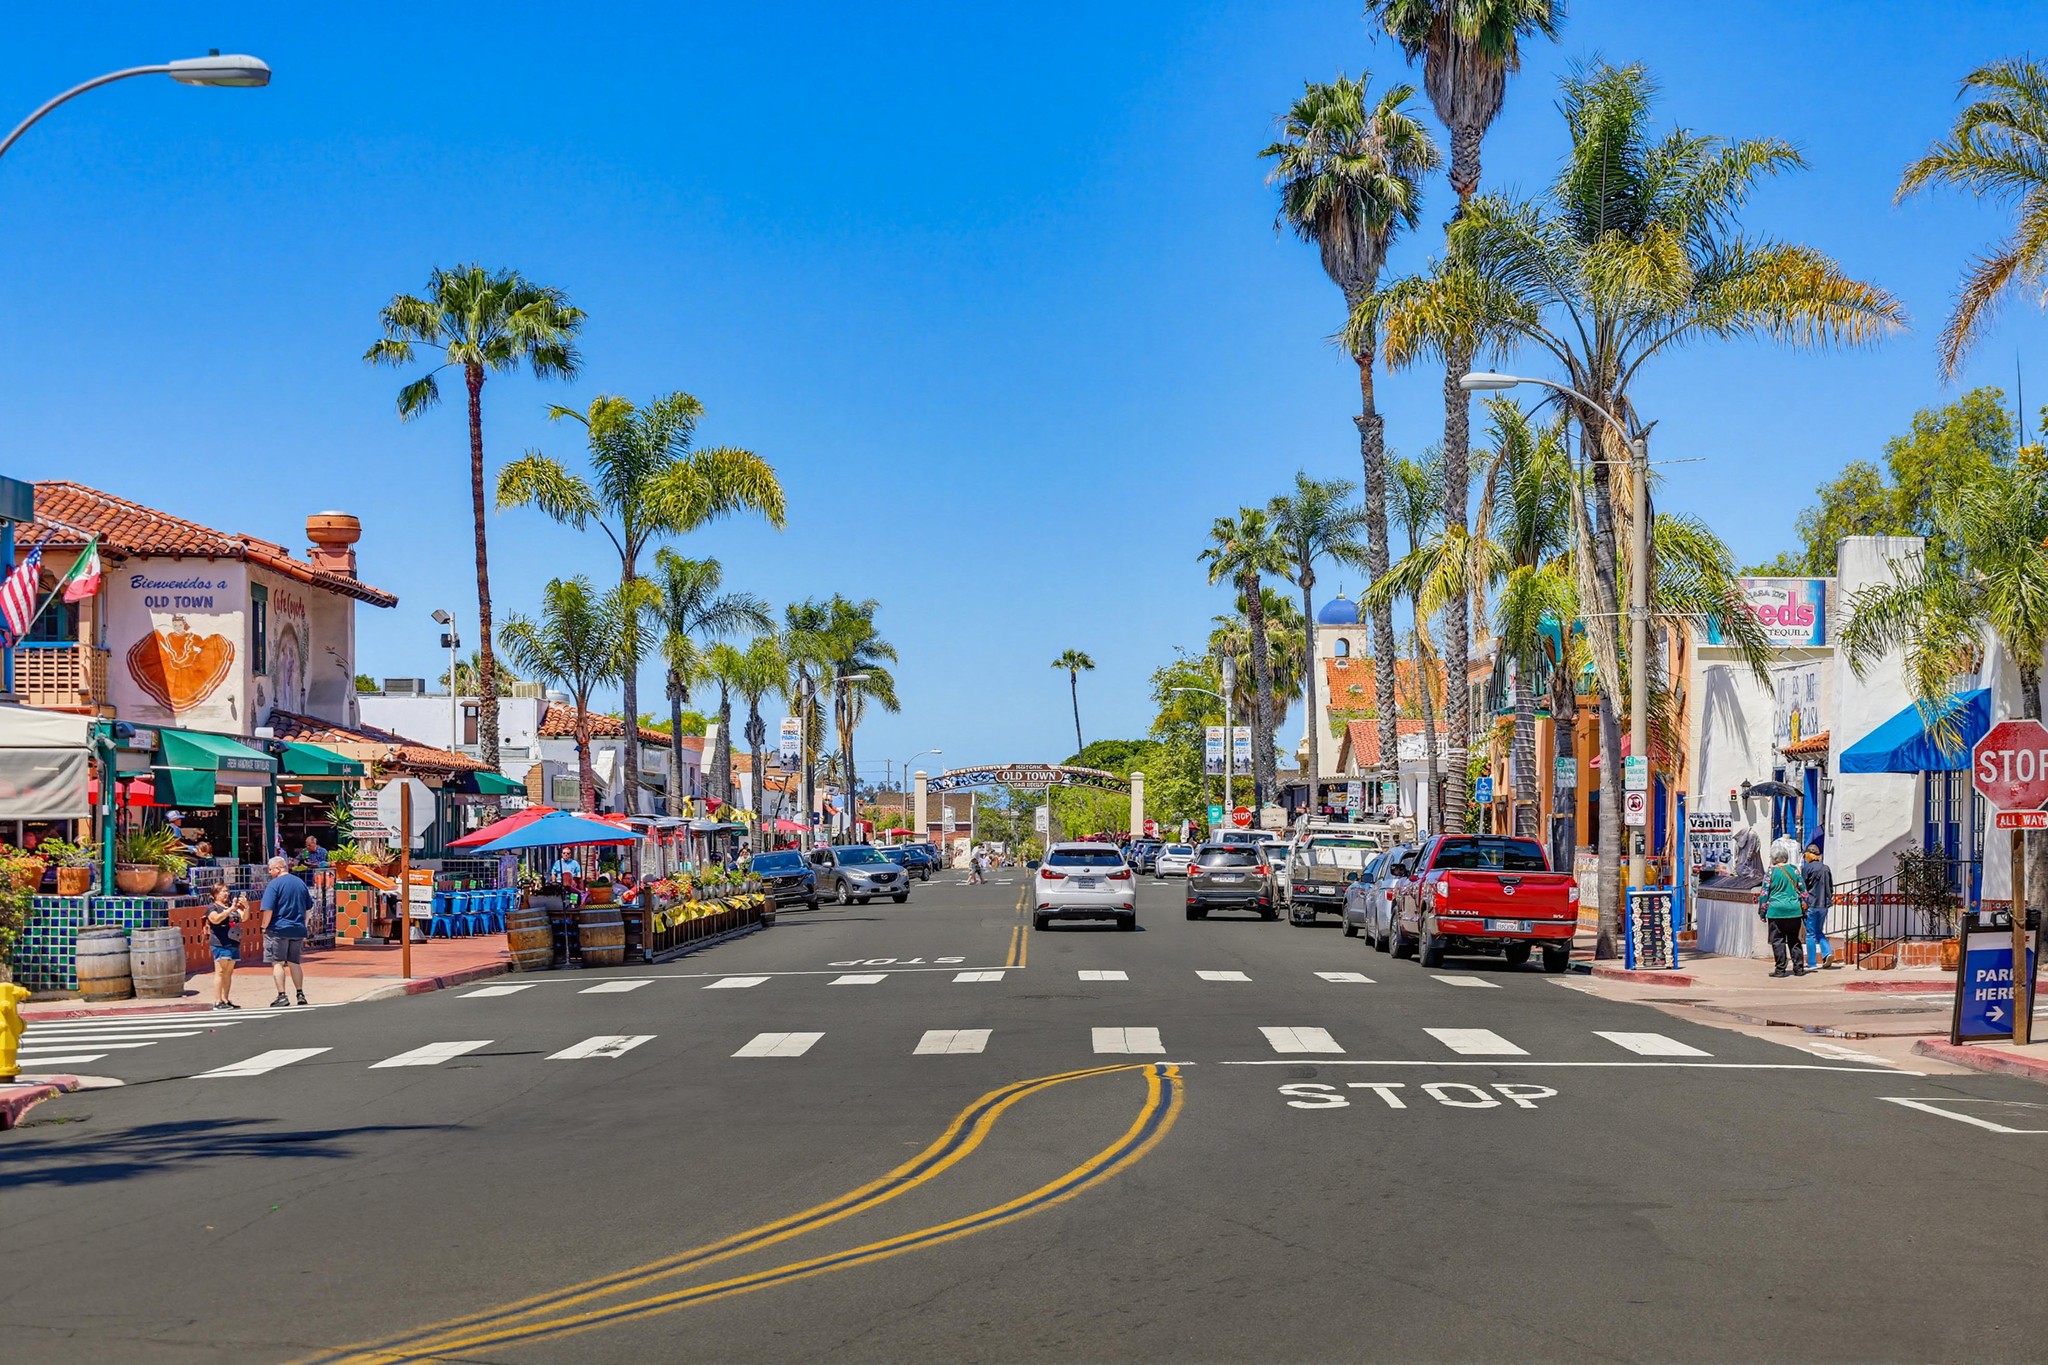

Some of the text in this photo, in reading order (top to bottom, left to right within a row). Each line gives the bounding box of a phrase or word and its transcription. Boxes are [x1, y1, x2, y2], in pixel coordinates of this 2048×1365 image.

[130, 574, 228, 589] Bienvenidos a
[145, 596, 213, 608] OLD TOWN
[1728, 591, 1815, 627] eds
[1769, 628, 1809, 637] TEQUILA
[1002, 771, 1056, 781] OLD TOWN
[1348, 796, 1359, 807] 25
[1233, 812, 1251, 821] STOP
[2000, 815, 2045, 826] ALL WAY
[1690, 818, 1732, 828] Vanilla
[827, 956, 966, 967] STOP
[1975, 987, 2014, 1001] HERE
[1278, 1082, 1558, 1109] STOP
